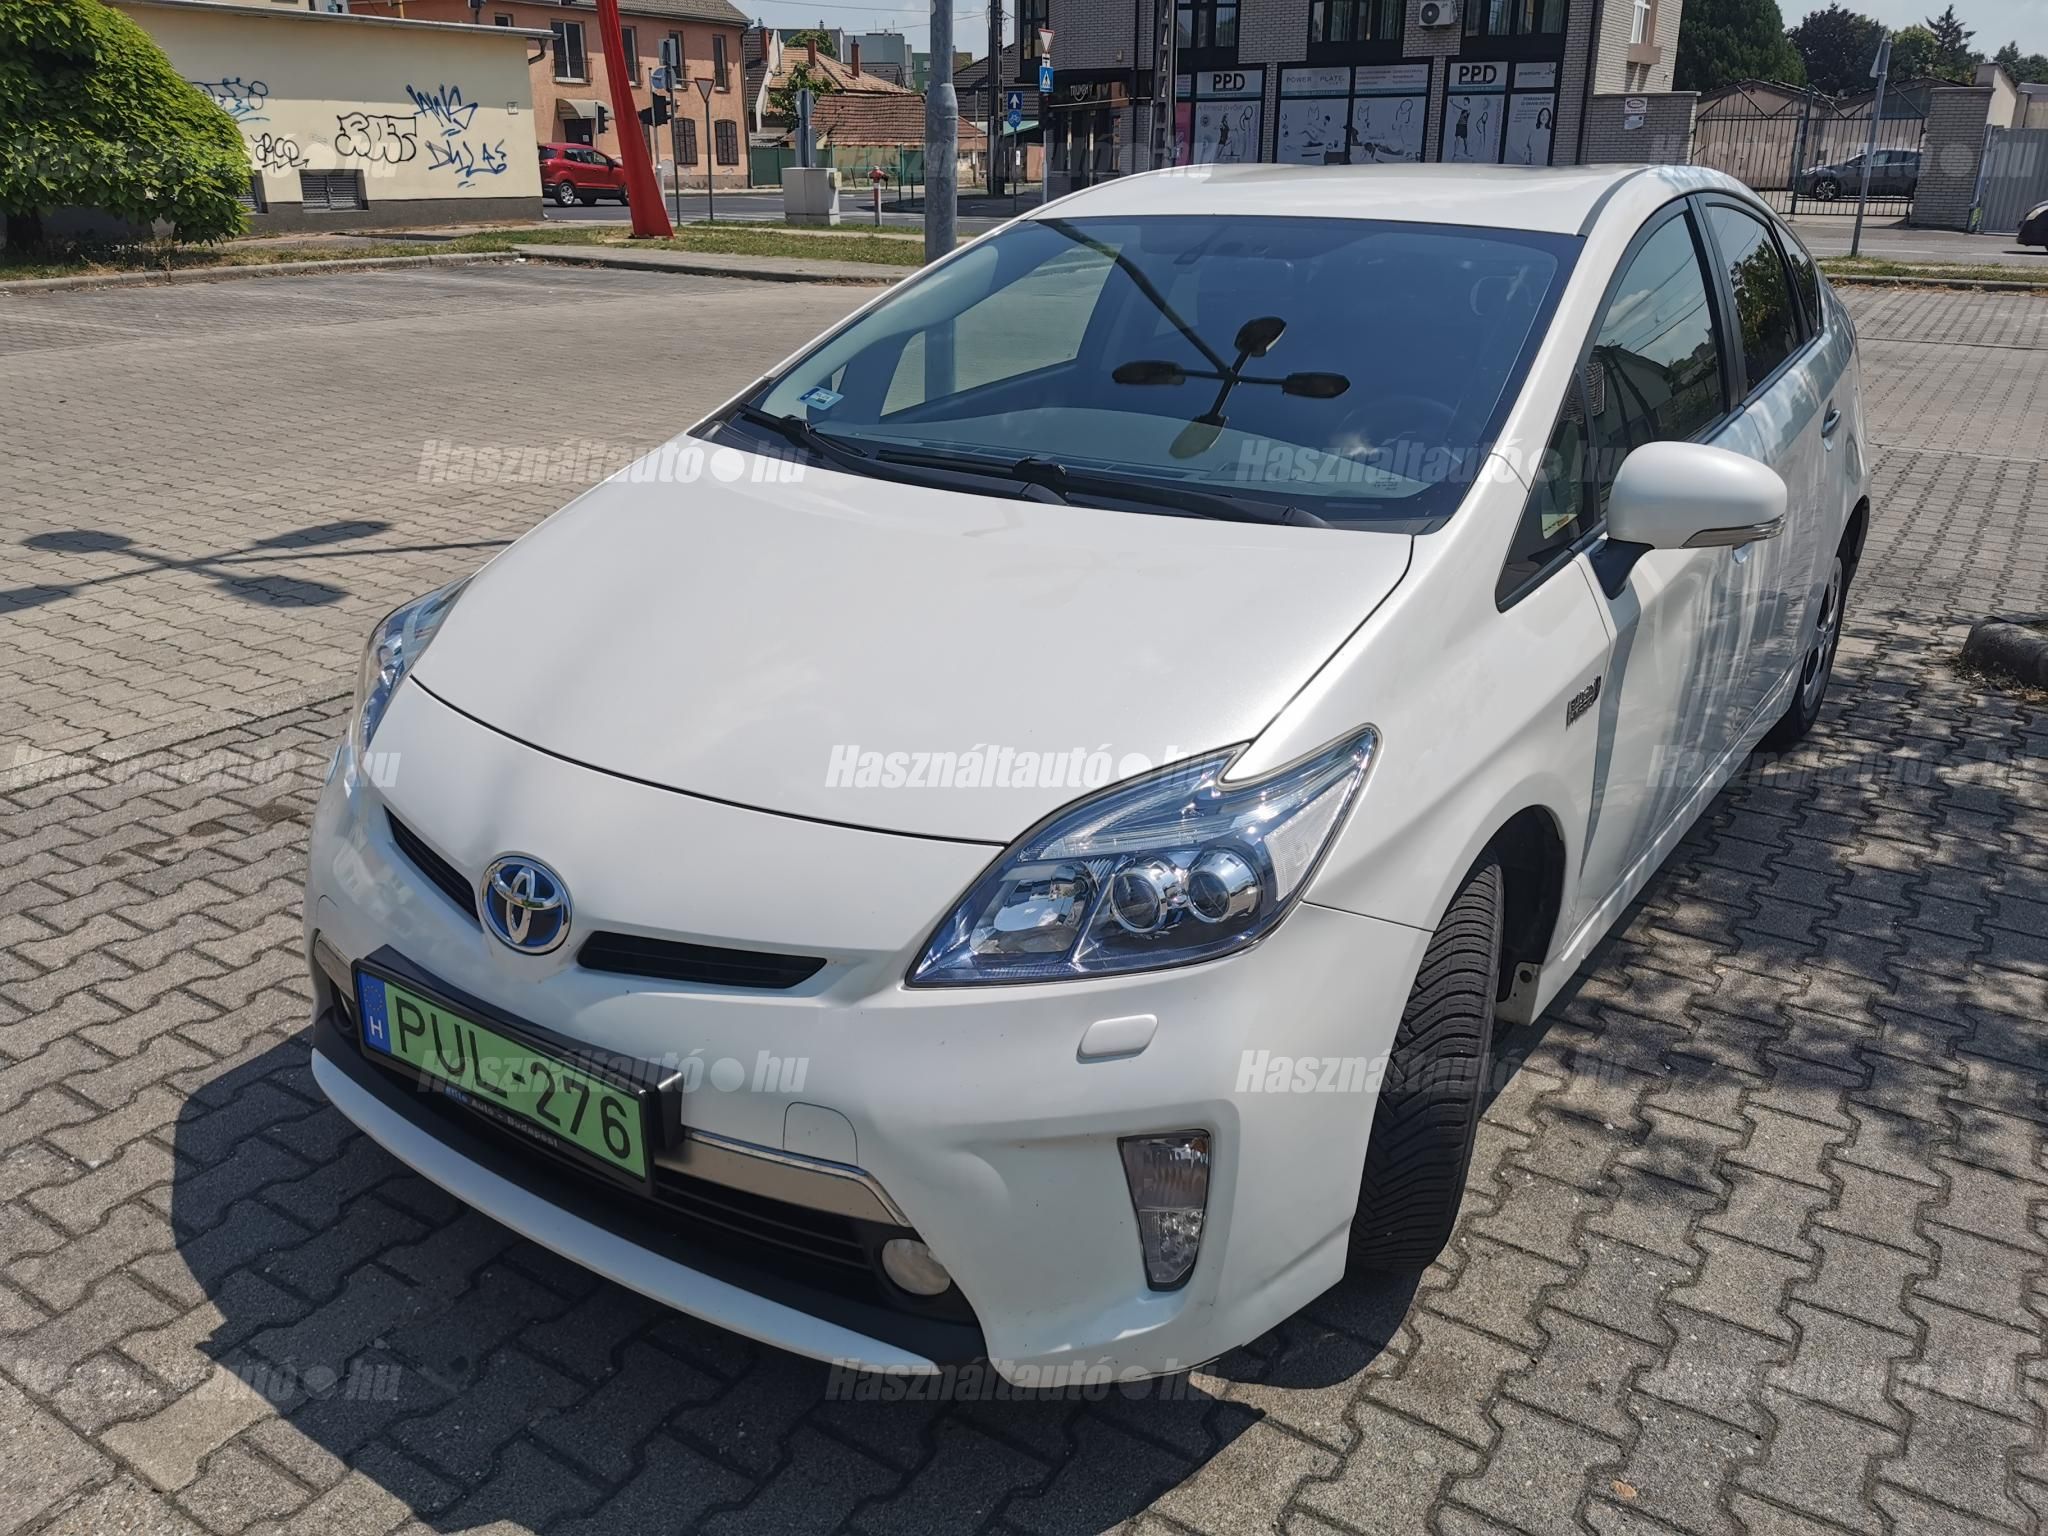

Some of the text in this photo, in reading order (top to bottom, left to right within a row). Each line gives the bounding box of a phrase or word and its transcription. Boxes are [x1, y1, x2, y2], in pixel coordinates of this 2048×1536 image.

[1212, 73, 1246, 92] PPD
[1286, 76, 1312, 84] POWER
[1458, 65, 1497, 85] PPD
[369, 1015, 383, 1040] H
[395, 995, 631, 1160] PUL-276
[506, 1115, 560, 1148] Budapest
